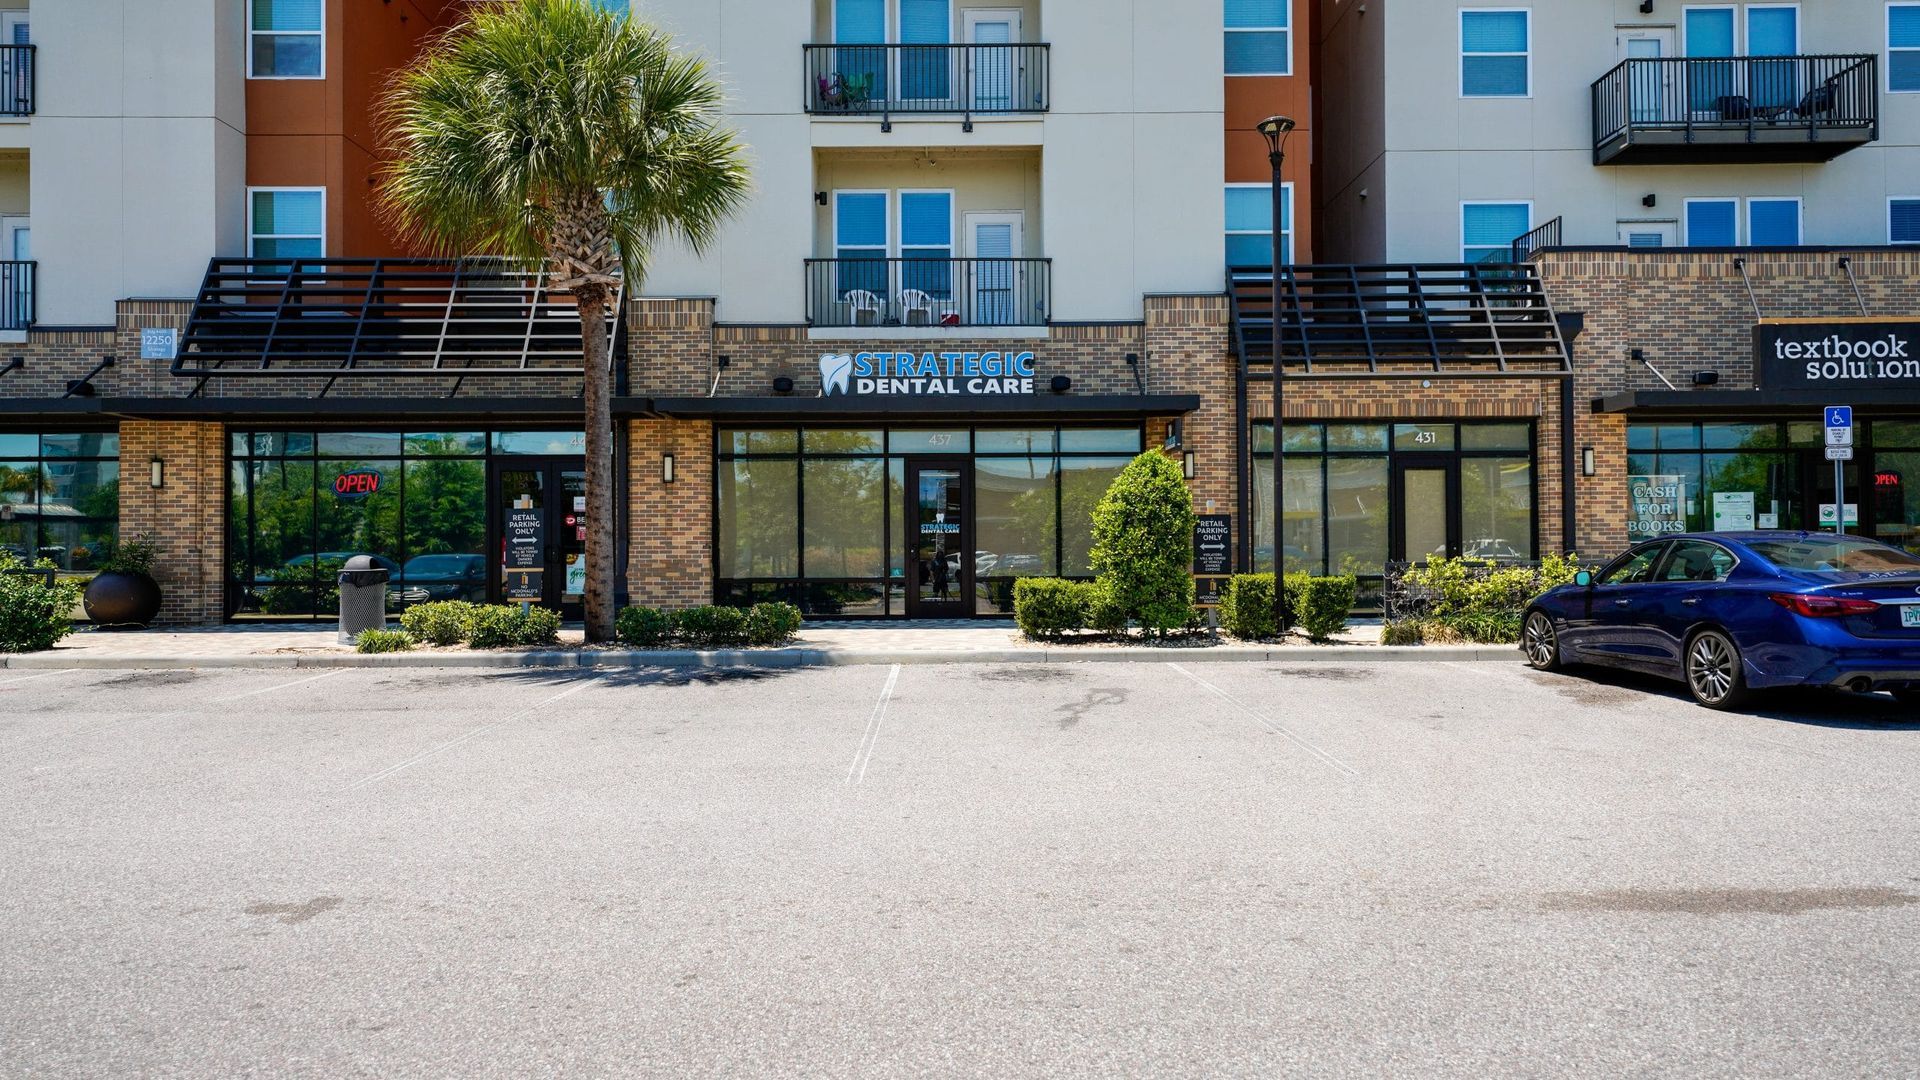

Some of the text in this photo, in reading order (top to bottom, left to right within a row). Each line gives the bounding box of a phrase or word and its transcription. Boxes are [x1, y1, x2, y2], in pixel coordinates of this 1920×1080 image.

[142, 335, 172, 345] 12250
[1774, 334, 1908, 359] textbook
[855, 351, 1035, 377] STRATEGIC
[857, 378, 1034, 394] DENTAL CARE
[929, 434, 952, 446] 437
[1415, 431, 1436, 443] 431
[335, 473, 379, 493] OPEN
[1633, 485, 1677, 498] CASH
[1637, 503, 1673, 515] FOR
[509, 520, 541, 528] PARKING
[1627, 520, 1685, 532] BOOKS
